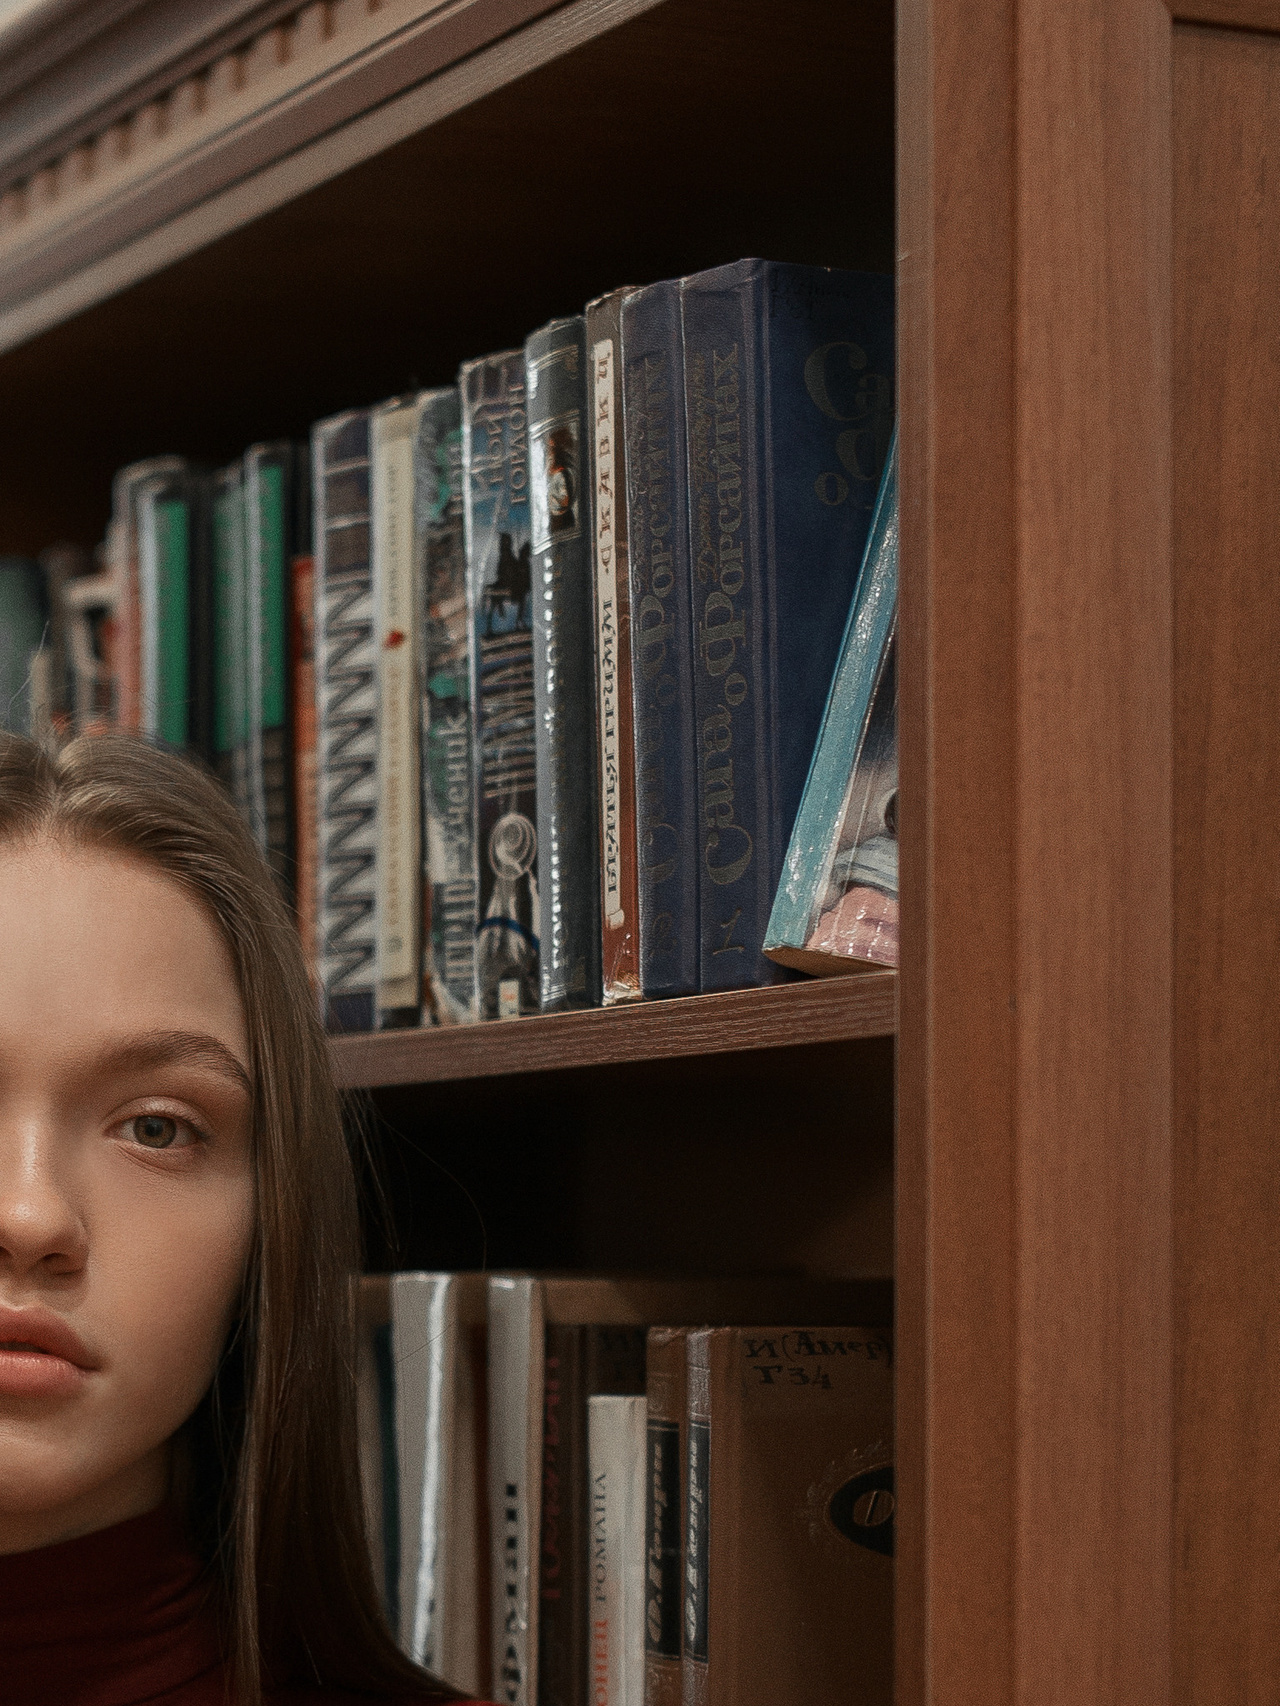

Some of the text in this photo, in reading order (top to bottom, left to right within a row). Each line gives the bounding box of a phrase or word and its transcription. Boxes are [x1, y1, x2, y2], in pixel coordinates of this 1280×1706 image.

[507, 382, 528, 504] ГОРДОН
[599, 599, 616, 739] ГРИММ
[698, 342, 753, 886] Сага о Форсайтах
[603, 748, 619, 895] БРАТЬЯ
[593, 1472, 607, 1603] РОМАНА
